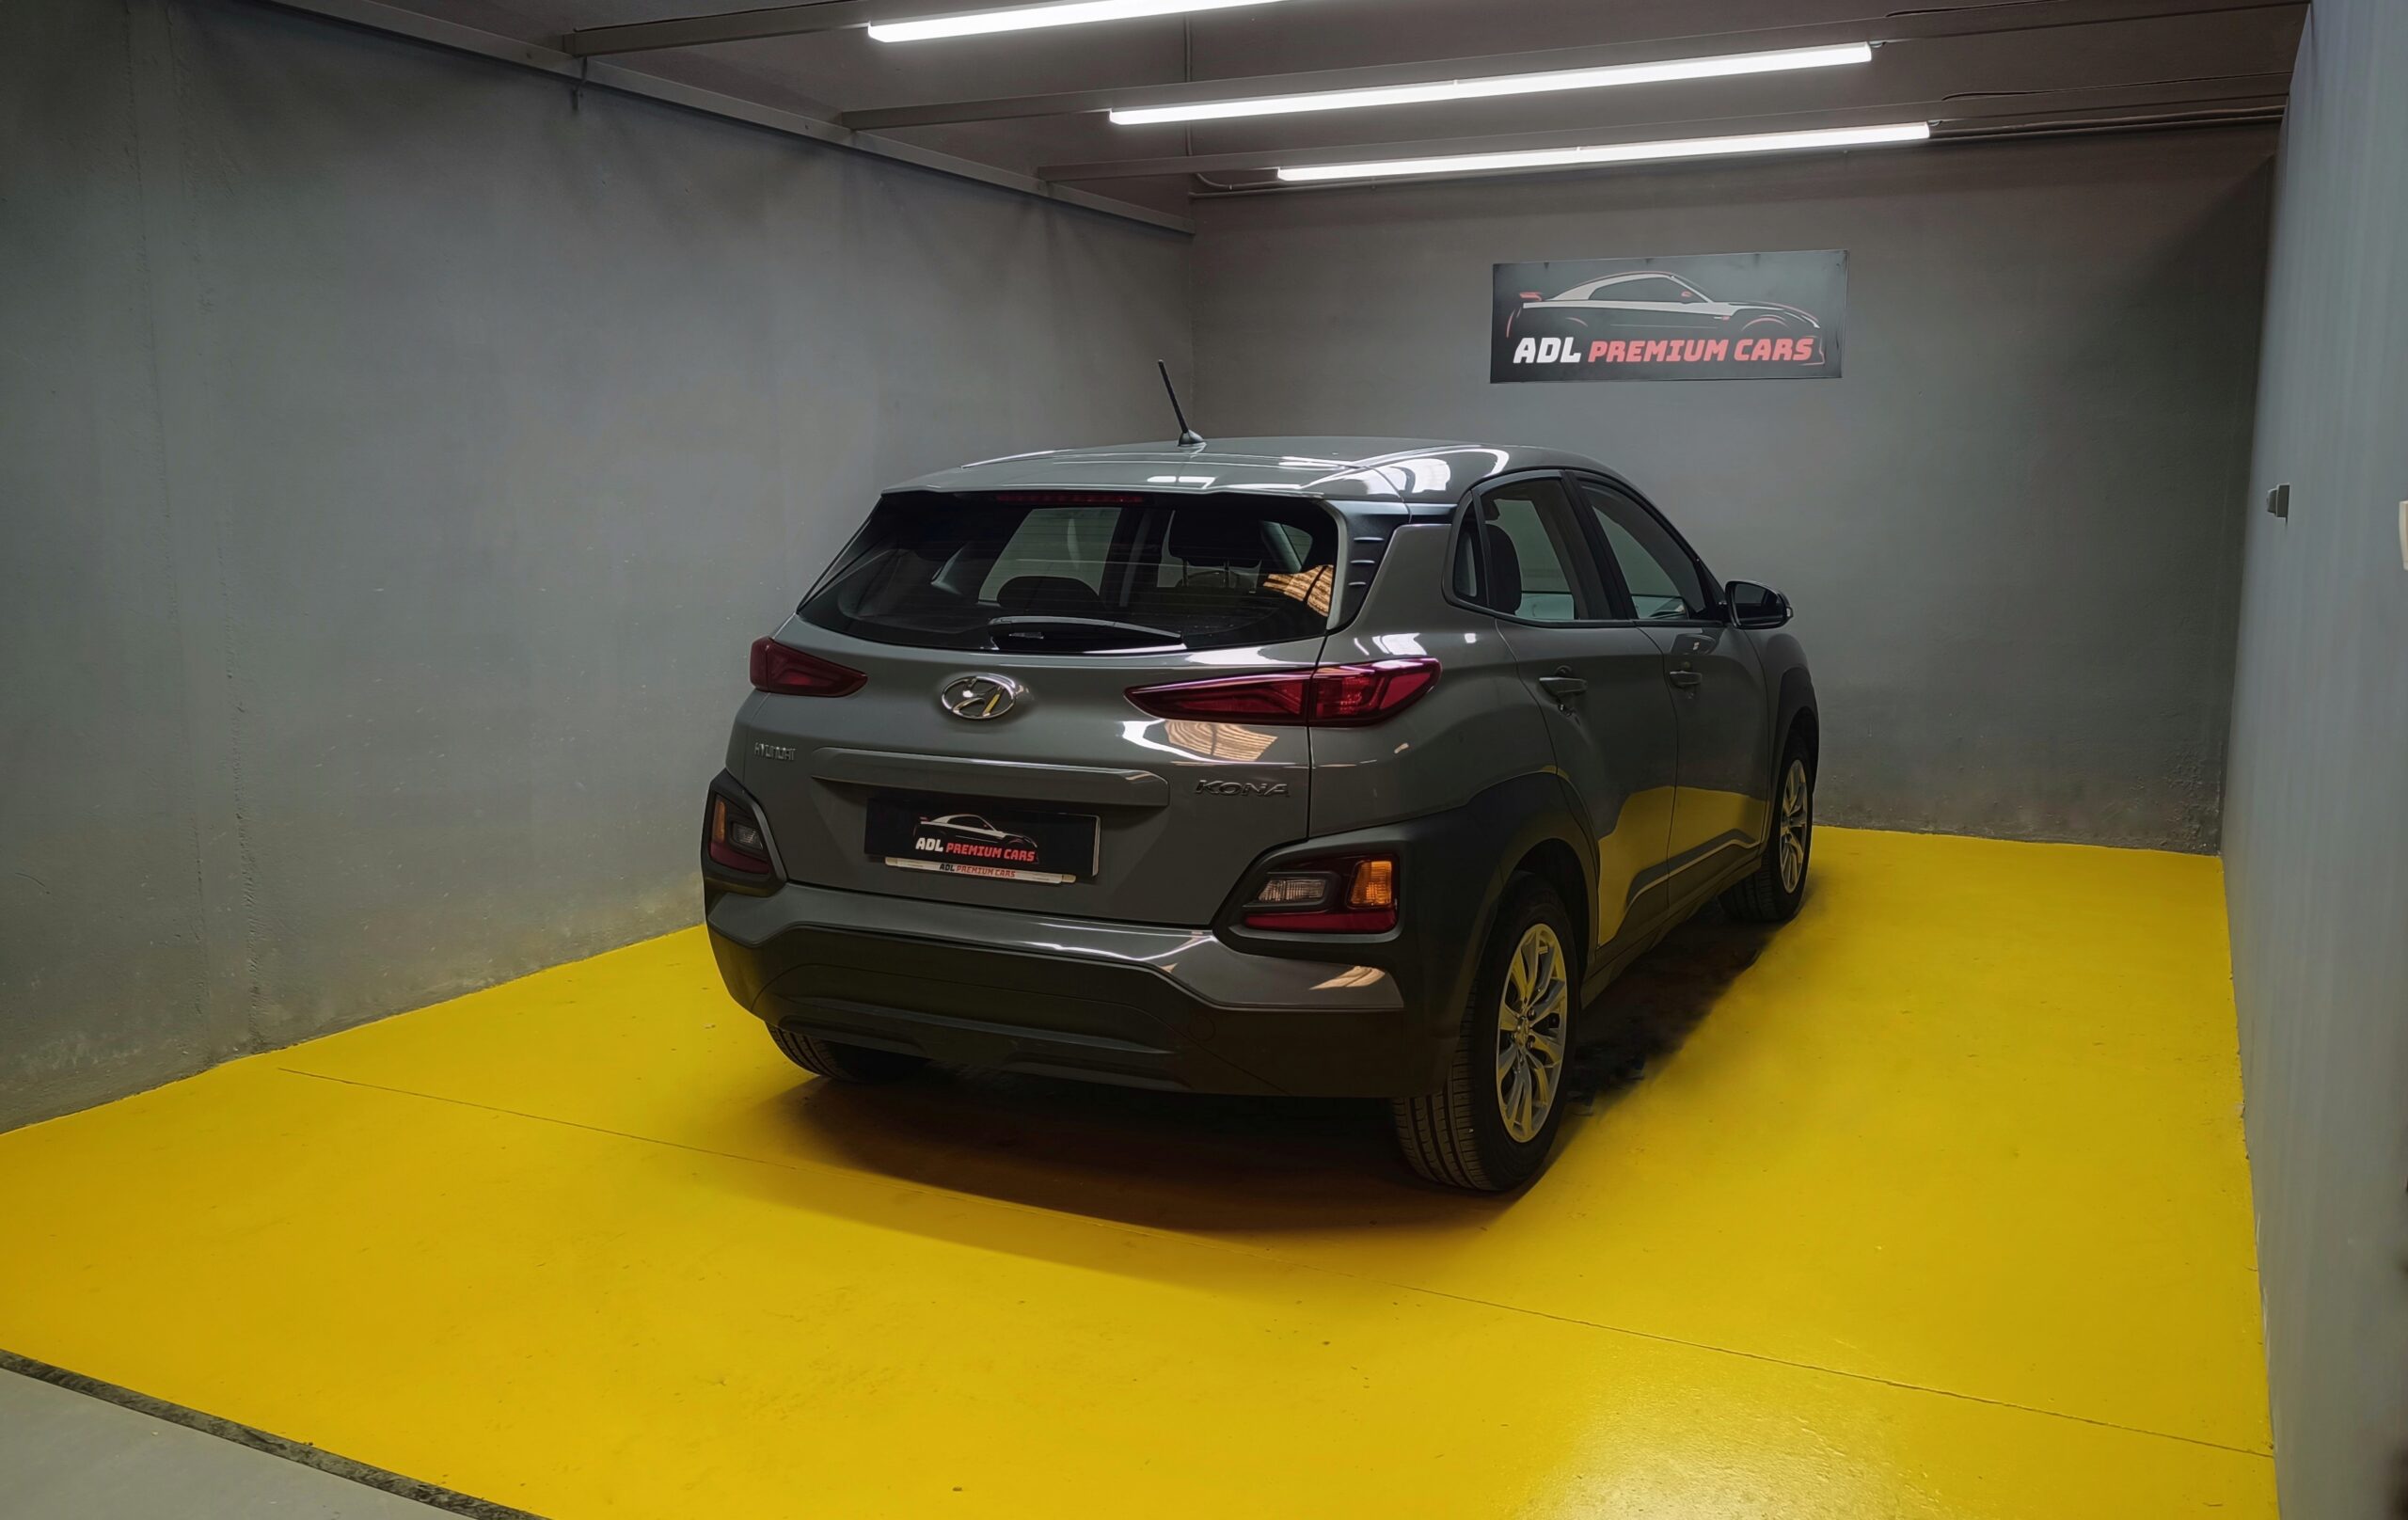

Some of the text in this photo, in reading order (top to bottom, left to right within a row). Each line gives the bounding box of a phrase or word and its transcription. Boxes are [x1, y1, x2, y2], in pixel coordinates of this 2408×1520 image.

[1513, 337, 1814, 364] ADL PREMIUM CARS
[1195, 780, 1289, 797] KONA
[915, 837, 1035, 862] ADL PREMIUM CARS
[939, 863, 955, 872] ADL
[957, 865, 994, 876] PREMIUM
